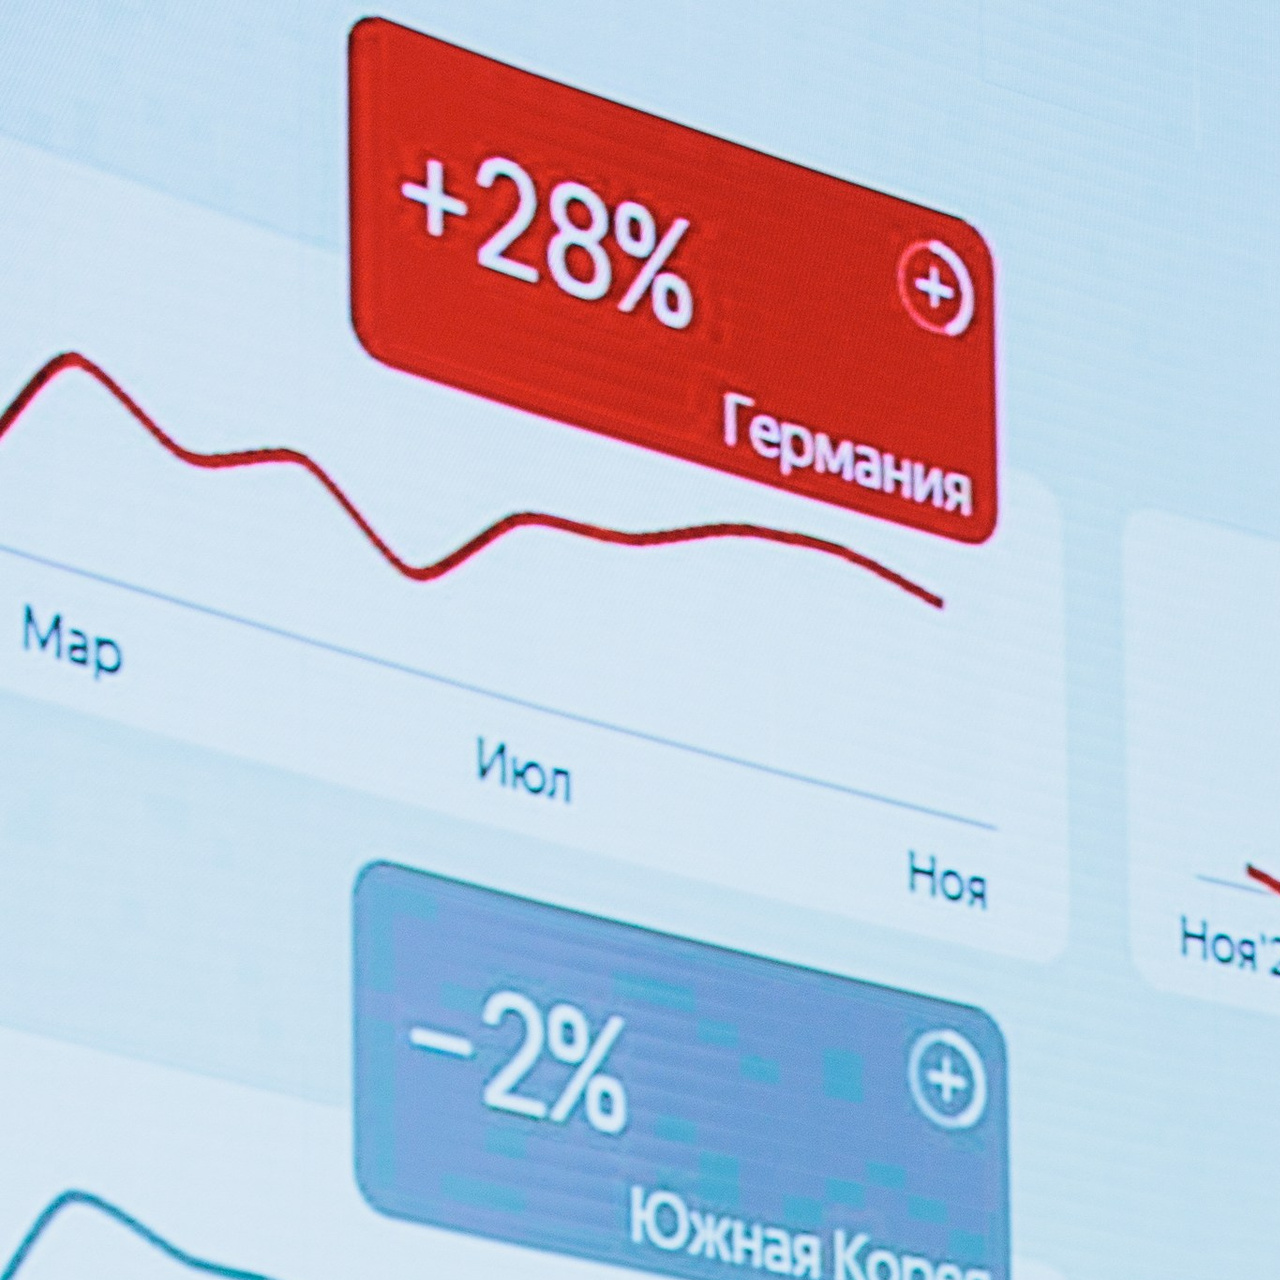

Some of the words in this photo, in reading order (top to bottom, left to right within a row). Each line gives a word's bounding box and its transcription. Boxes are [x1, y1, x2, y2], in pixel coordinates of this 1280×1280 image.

[402, 156, 694, 330] +28%
[723, 392, 973, 517] Германия
[23, 603, 123, 682] Мар
[477, 736, 573, 804] Июл
[908, 849, 988, 911] Ноя
[631, 1185, 822, 1280] Южная
